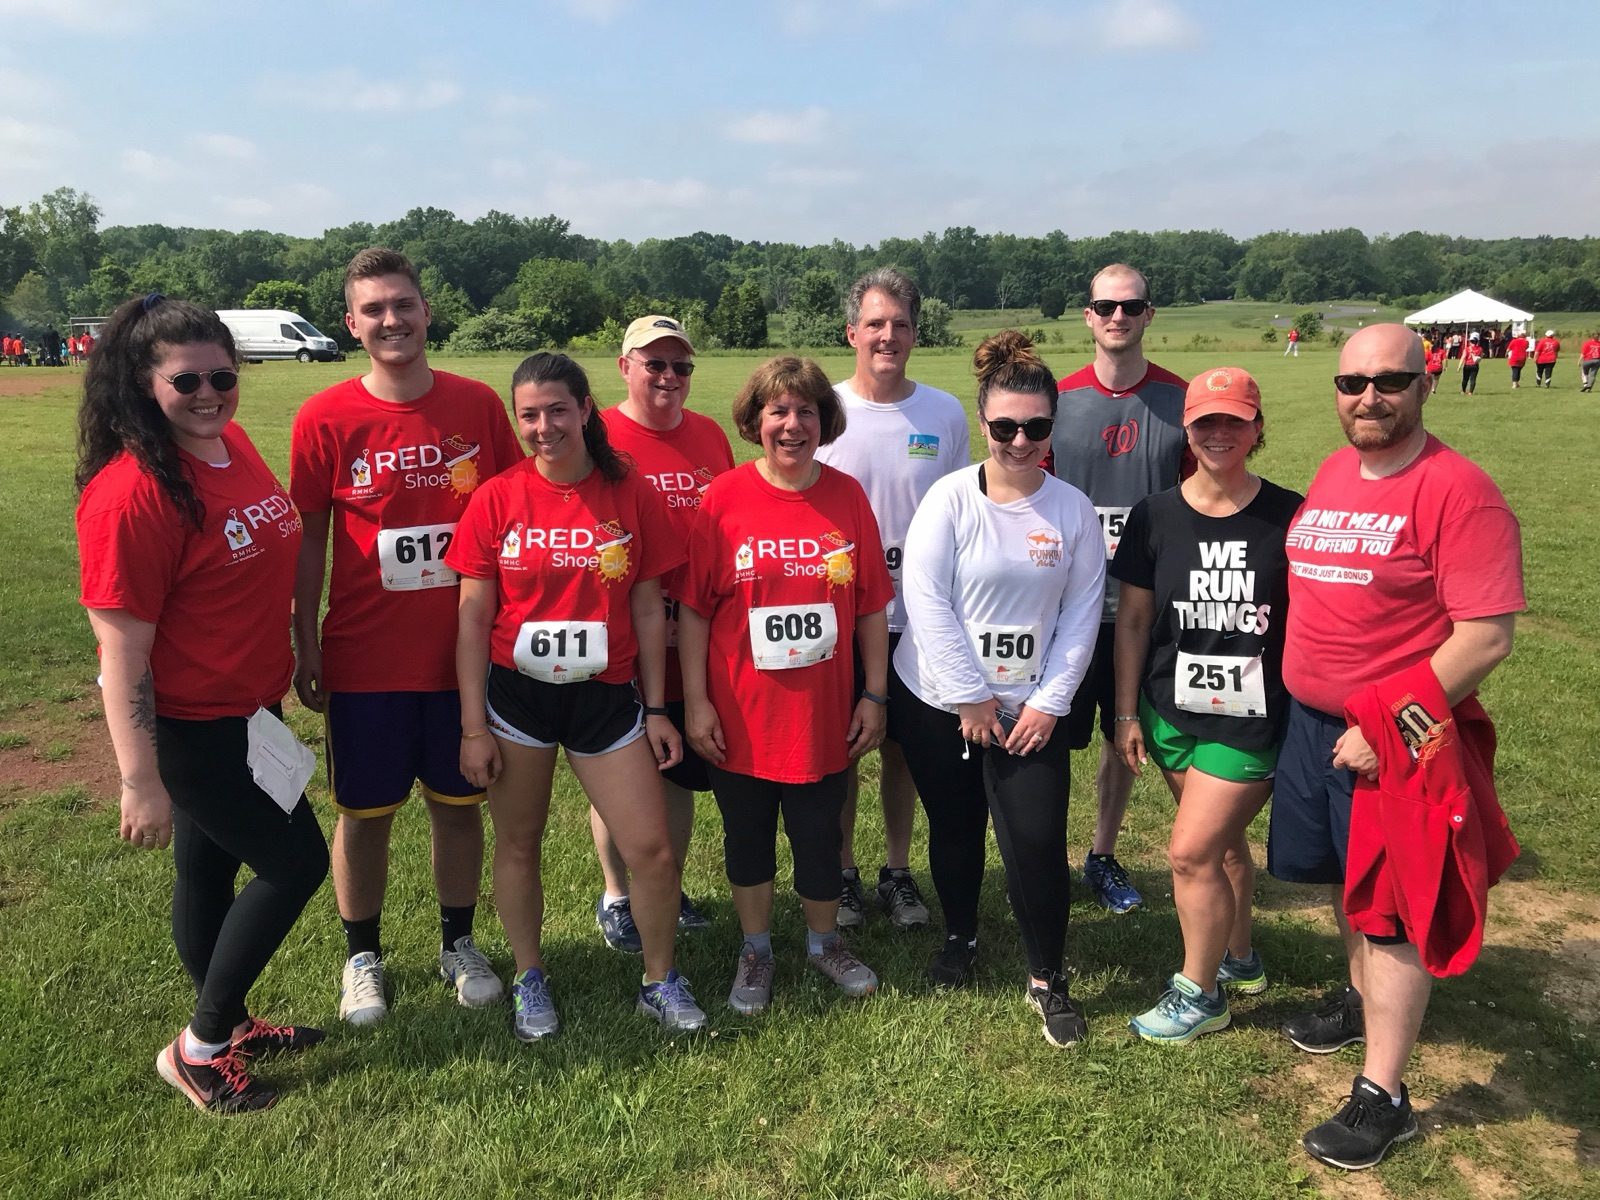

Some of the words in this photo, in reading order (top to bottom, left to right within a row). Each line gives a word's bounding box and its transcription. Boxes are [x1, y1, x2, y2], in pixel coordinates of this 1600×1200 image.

[375, 445, 442, 474] RED
[243, 495, 288, 530] RED
[1346, 512, 1408, 533] MEAN
[232, 545, 257, 559] RMHC
[395, 532, 454, 564] 612
[526, 528, 594, 549] RED
[758, 538, 820, 559] RED
[1297, 535, 1313, 551] TO
[1313, 537, 1358, 554] OFFEND
[1360, 539, 1393, 556] YOU
[1199, 541, 1248, 569] WE
[1190, 570, 1256, 602] RUN
[1301, 566, 1318, 577] WAS
[1319, 569, 1336, 579] JUST
[1337, 571, 1344, 579] A
[1343, 570, 1369, 582] BONUS
[765, 612, 823, 642] 608
[1172, 601, 1271, 635] THINGS
[531, 629, 587, 658] 611
[979, 632, 1034, 660] 150
[1187, 663, 1242, 692] 251
